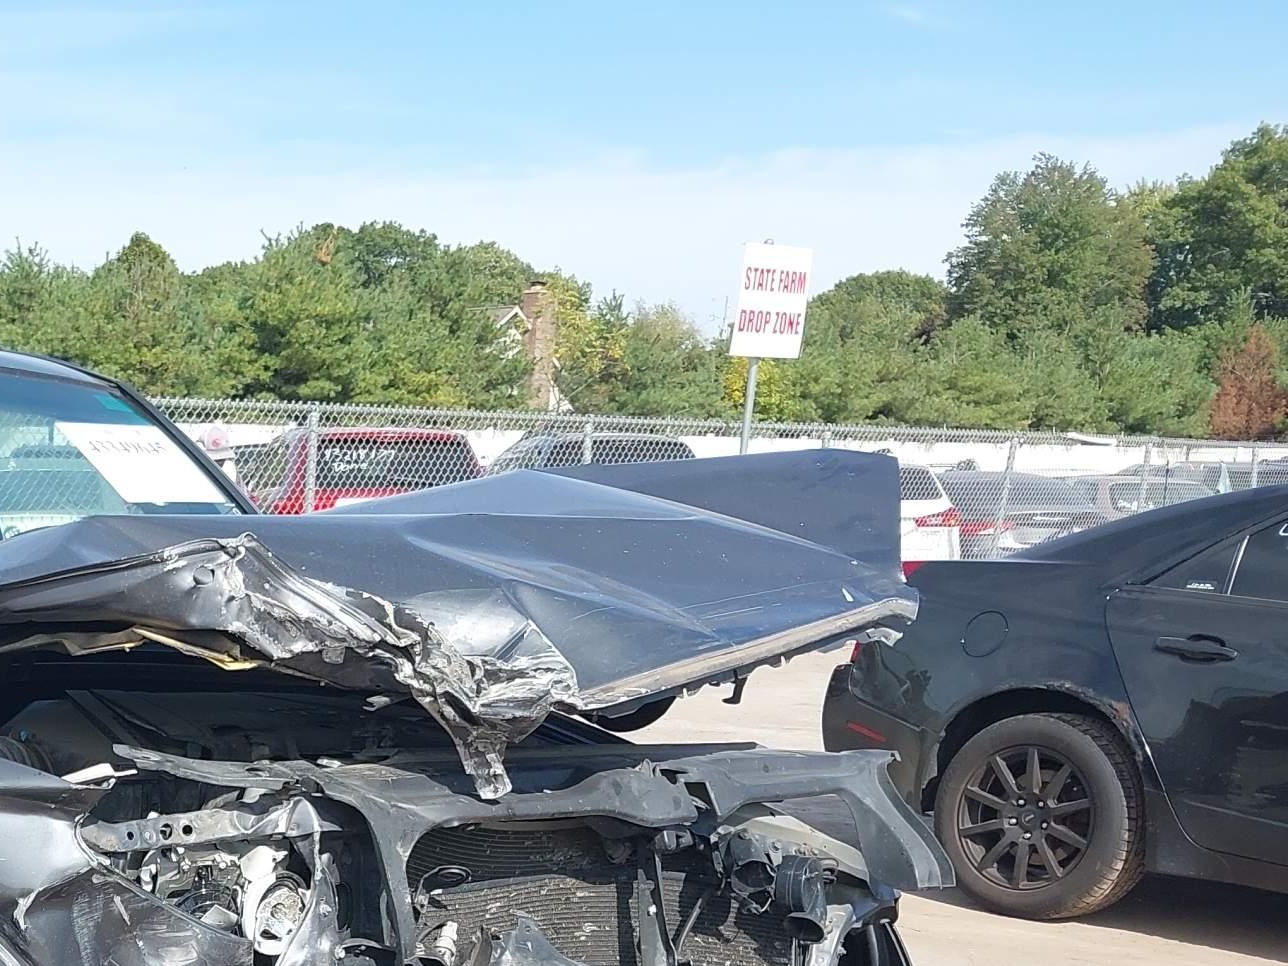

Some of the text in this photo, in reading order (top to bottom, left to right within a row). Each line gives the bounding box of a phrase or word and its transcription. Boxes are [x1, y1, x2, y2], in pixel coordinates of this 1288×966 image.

[744, 266, 807, 295] STATE FARM
[738, 308, 802, 335] DROP ZONE
